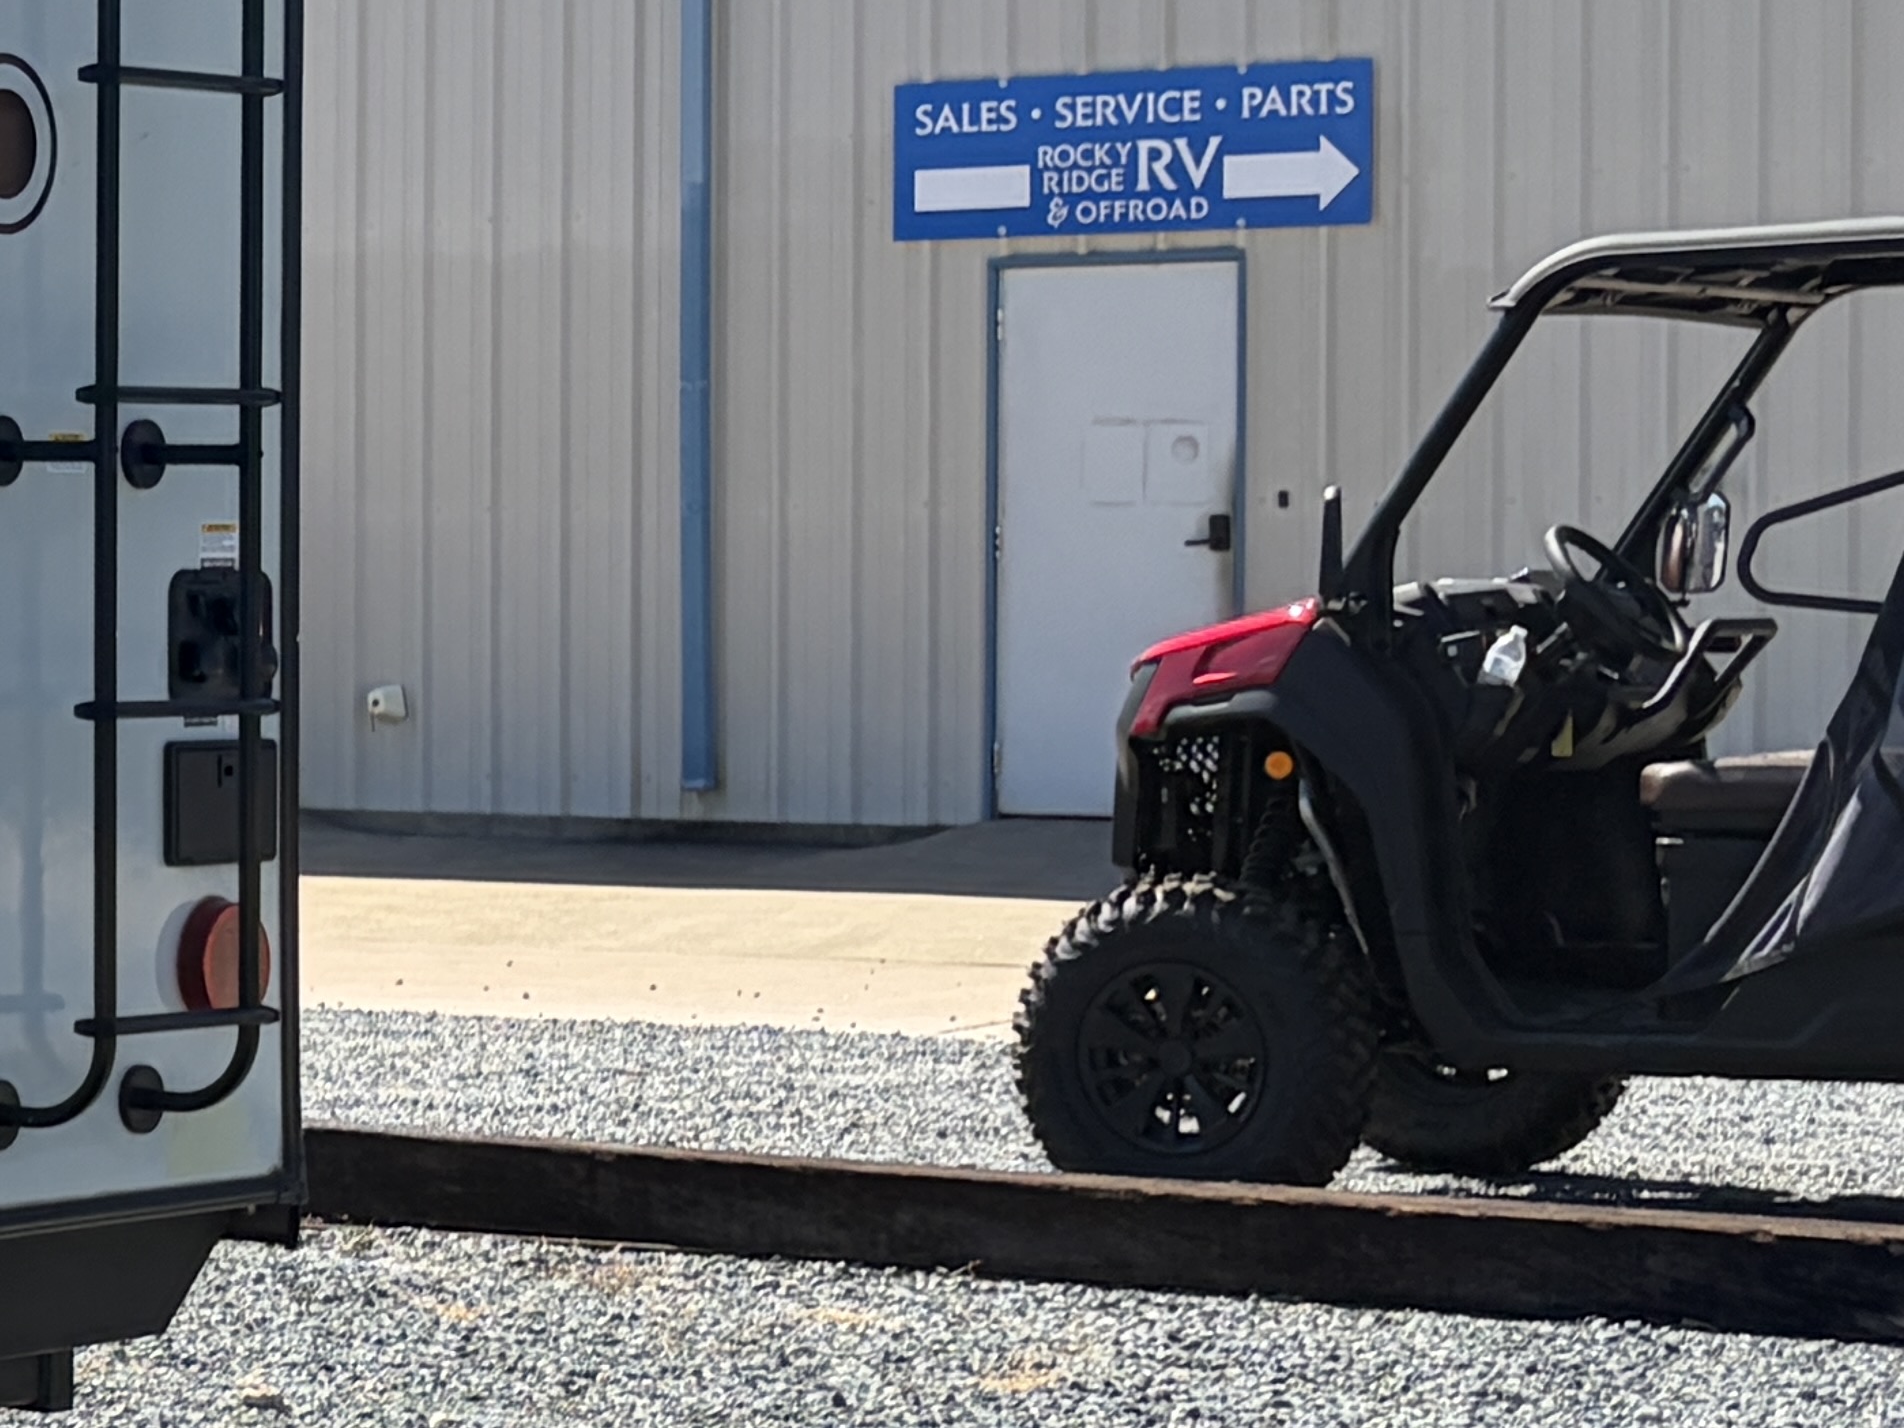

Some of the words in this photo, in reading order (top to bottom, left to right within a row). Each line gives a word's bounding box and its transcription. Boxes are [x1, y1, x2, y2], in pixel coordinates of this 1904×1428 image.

[914, 99, 1018, 136] SALES
[1054, 89, 1202, 129] SERVICE
[1241, 81, 1355, 119] PARTS
[1037, 140, 1133, 169] ROCKY
[1135, 134, 1223, 193] RV
[1041, 168, 1125, 195] RIDGE
[1046, 196, 1069, 228] &
[1074, 196, 1209, 226] OFFROAD
